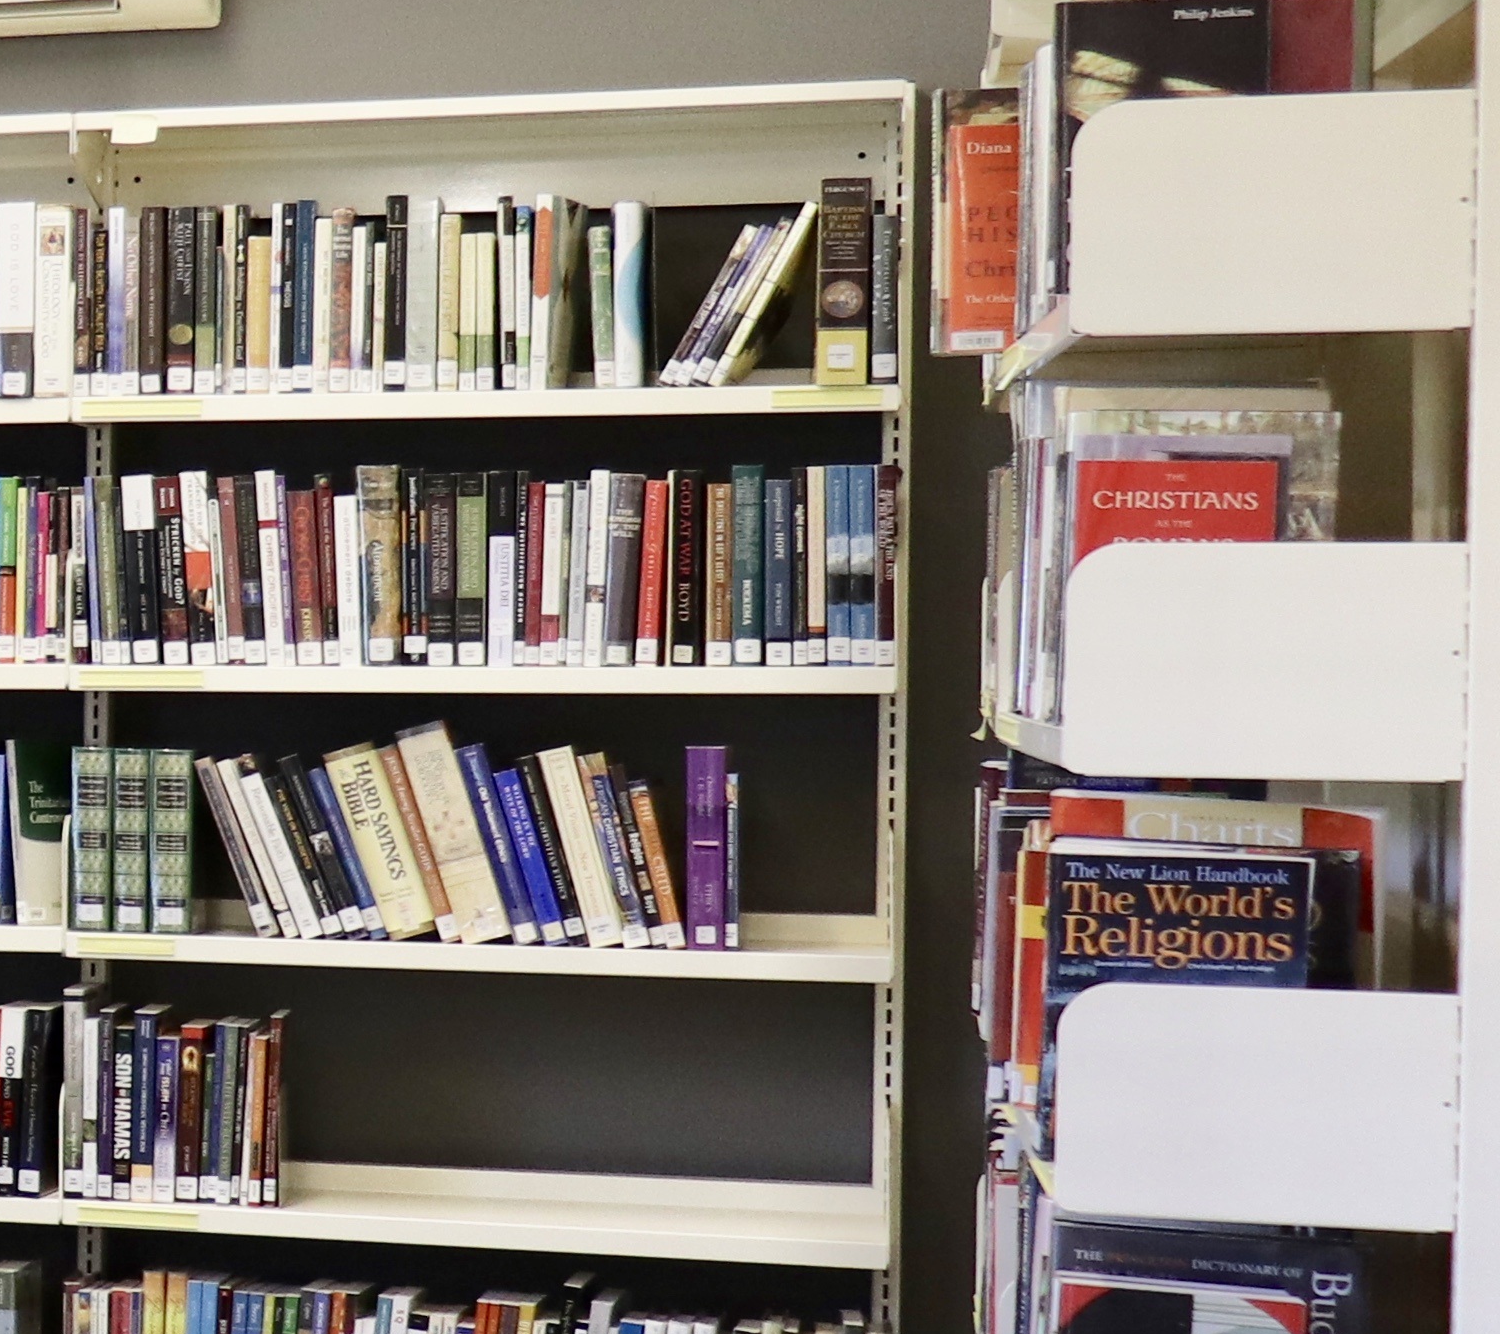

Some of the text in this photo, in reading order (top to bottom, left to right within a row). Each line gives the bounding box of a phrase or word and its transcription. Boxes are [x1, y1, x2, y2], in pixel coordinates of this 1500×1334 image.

[1174, 8, 1254, 21] Philip Jenkins
[1166, 473, 1186, 482] THE
[1093, 490, 1259, 510] CHRISTIANS
[170, 517, 182, 565] STRICKEN
[678, 478, 692, 622] GOD AT WAR BOYD
[774, 532, 785, 560] HOPE
[372, 541, 385, 603] Atonement
[173, 578, 185, 605] GOD?
[341, 782, 368, 830] BIBLE
[352, 761, 406, 881] HARD SAYINGS
[1127, 811, 1296, 846] Charts
[1066, 862, 1289, 885] The New Lion Handbook
[1062, 881, 1295, 919] The World's
[1061, 915, 1293, 969] Religions
[114, 1053, 132, 1159] SON HAMAS
[1074, 1248, 1104, 1261] THE
[1191, 1259, 1279, 1277] DICTIONARY
[1282, 1266, 1303, 1278] OF
